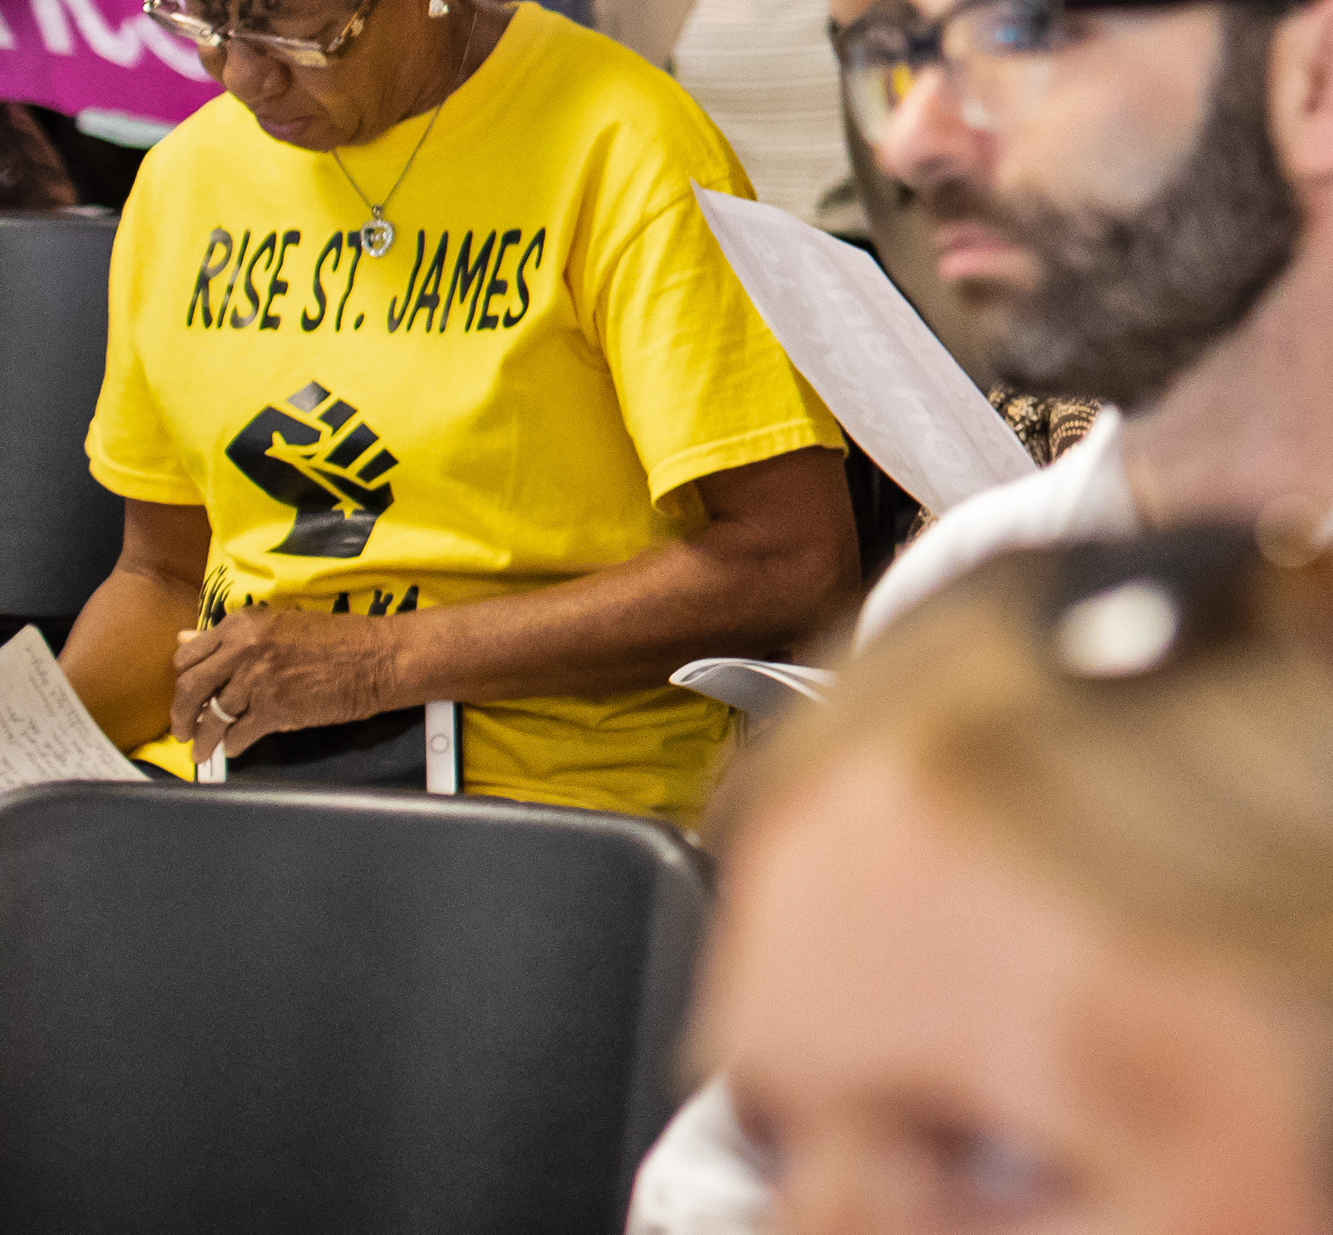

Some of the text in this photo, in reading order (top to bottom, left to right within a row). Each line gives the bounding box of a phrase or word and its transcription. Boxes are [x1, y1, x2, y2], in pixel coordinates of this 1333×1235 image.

[186, 225, 546, 334] RISE ST. JAMES
